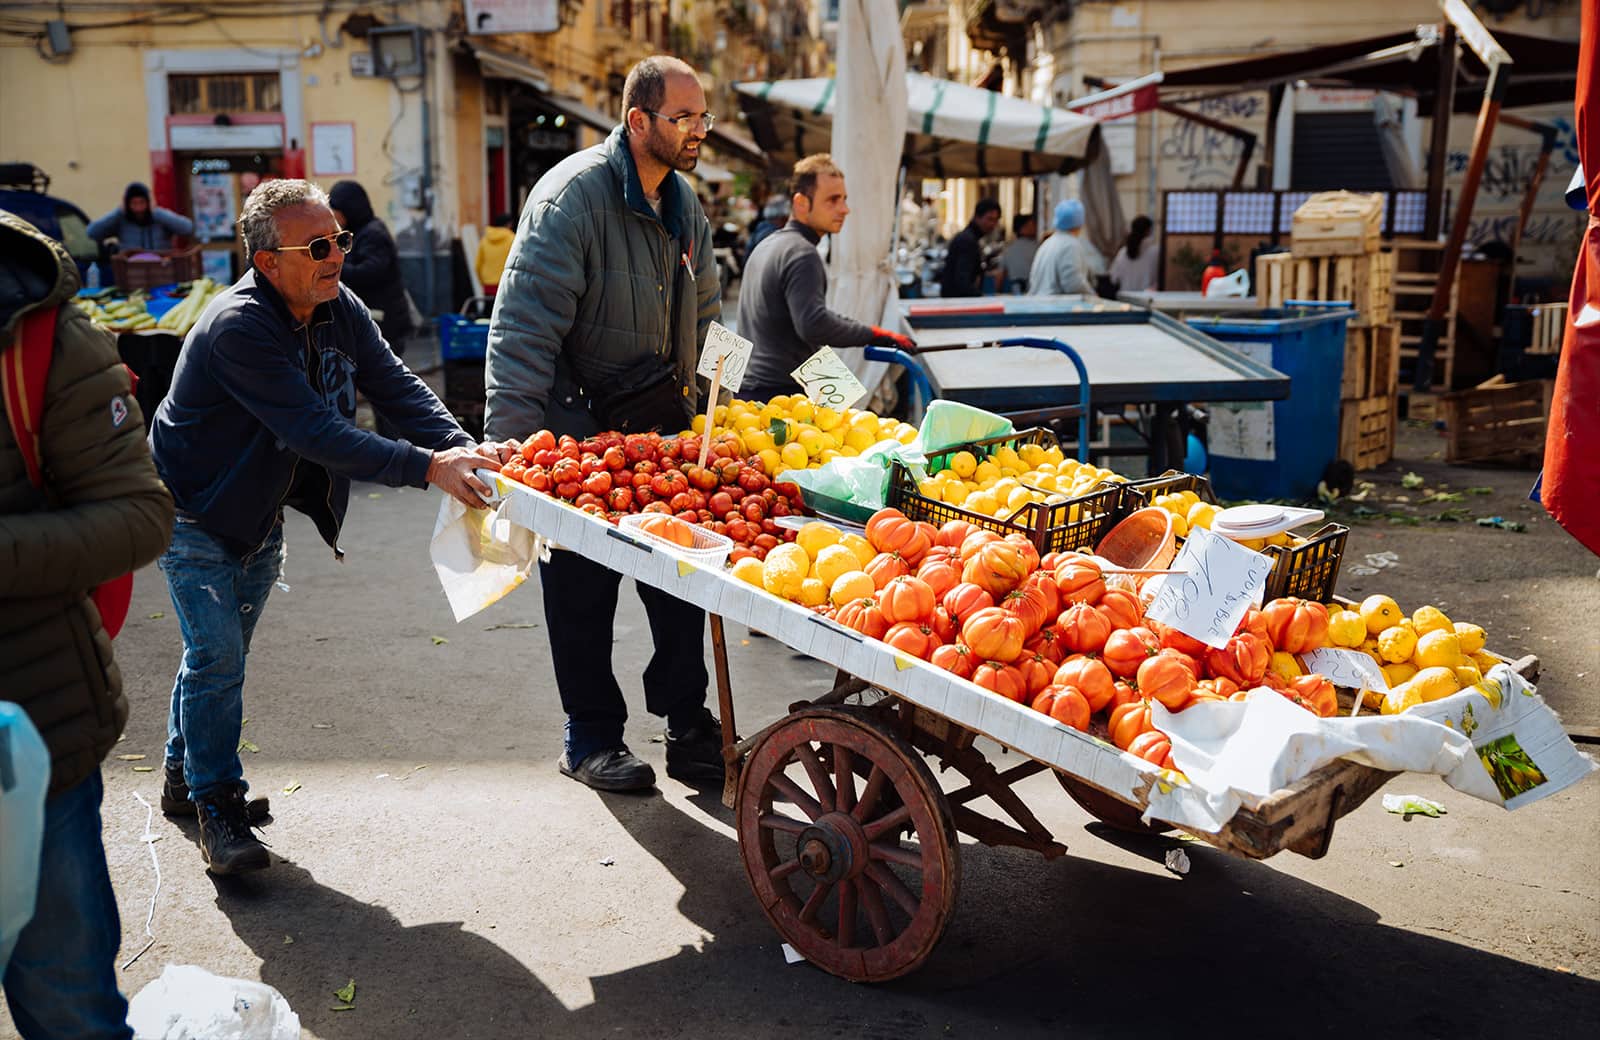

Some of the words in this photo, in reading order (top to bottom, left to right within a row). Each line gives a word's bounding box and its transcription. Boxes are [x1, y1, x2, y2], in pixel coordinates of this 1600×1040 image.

[709, 326, 745, 350] PACHINO
[1237, 555, 1268, 601] CUOR
[1207, 610, 1231, 637] BUE
